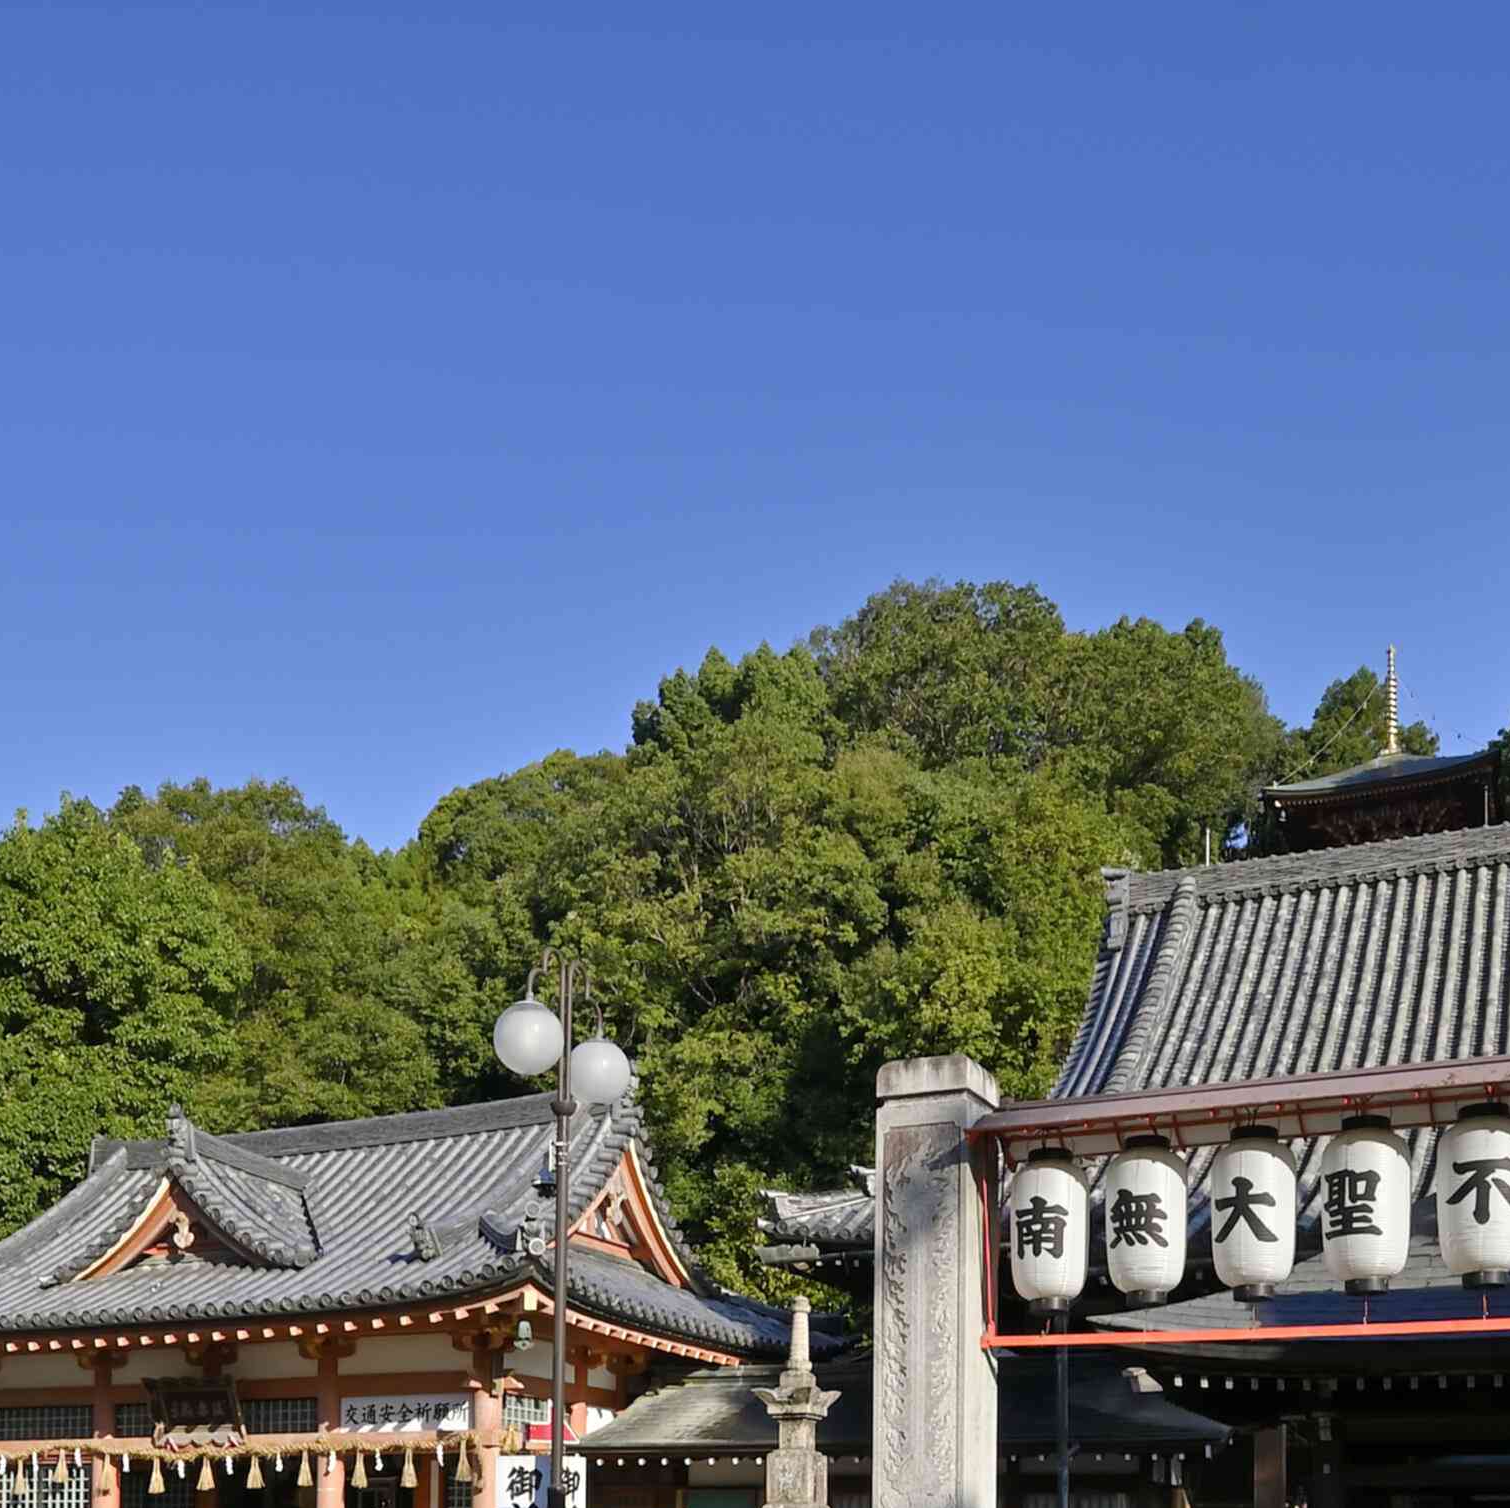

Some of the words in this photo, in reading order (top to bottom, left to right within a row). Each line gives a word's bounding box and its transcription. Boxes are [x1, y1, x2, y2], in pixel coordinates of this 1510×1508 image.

[344, 1400, 470, 1425] 交通安全祈願所
